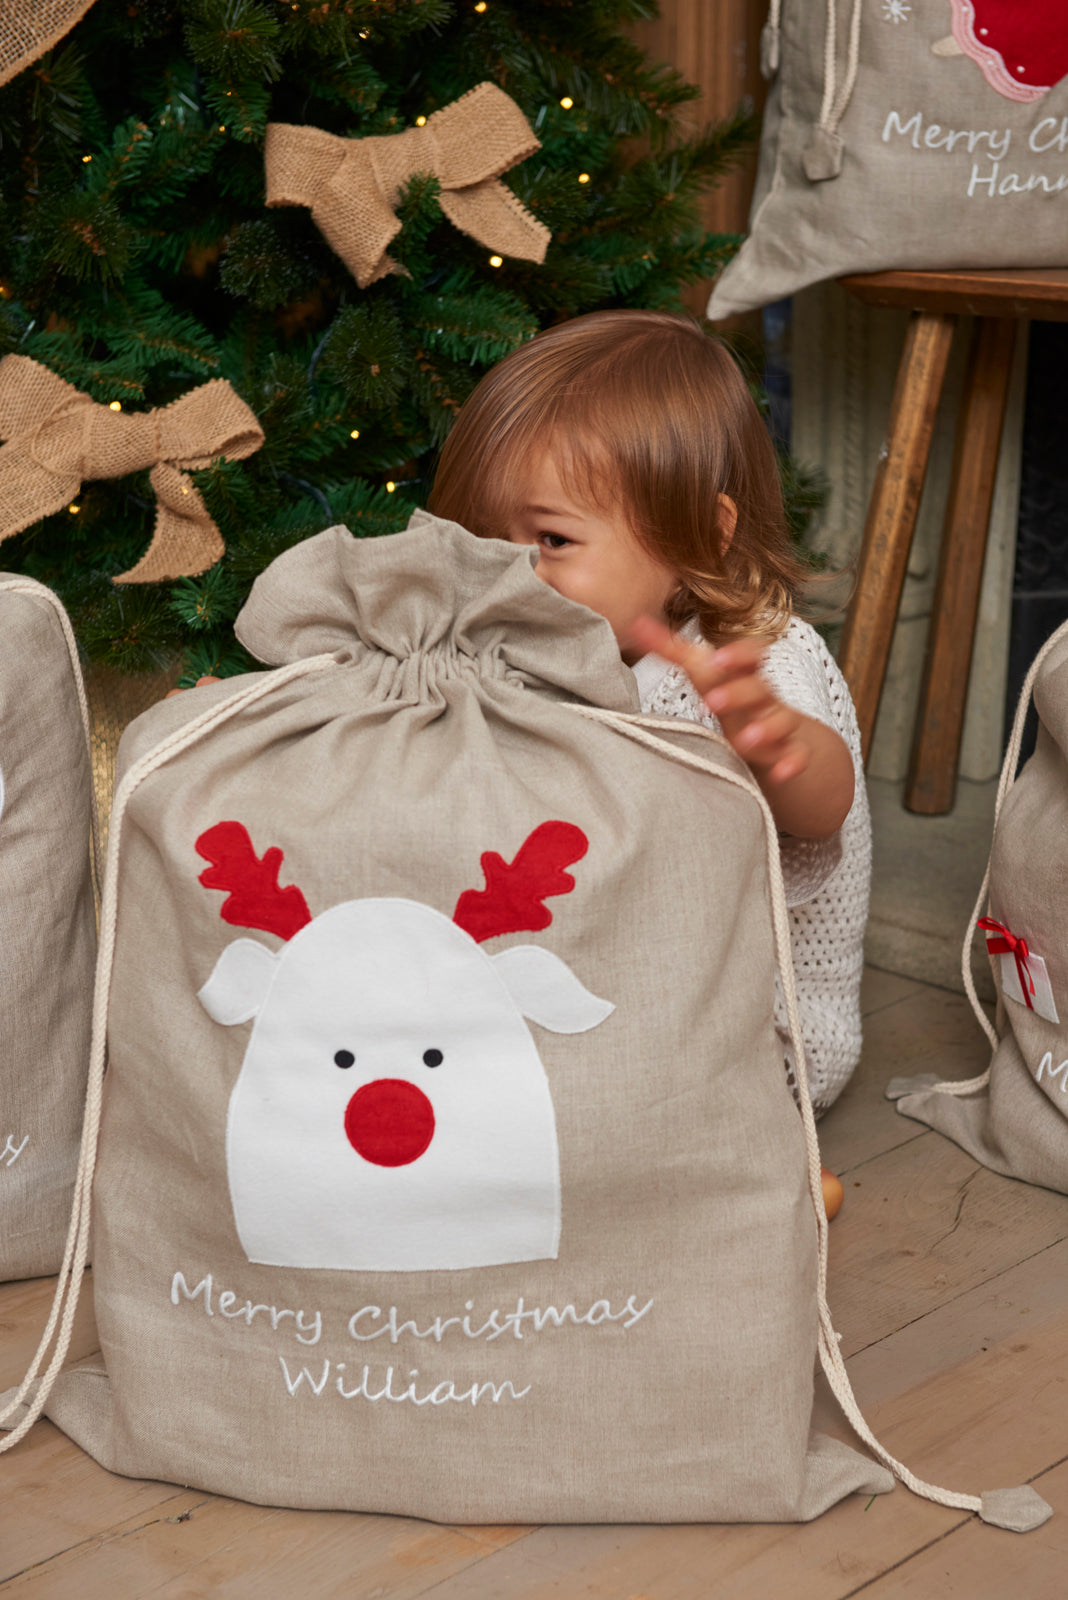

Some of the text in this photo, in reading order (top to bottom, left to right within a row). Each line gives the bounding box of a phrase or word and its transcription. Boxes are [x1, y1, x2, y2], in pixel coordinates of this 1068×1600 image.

[882, 111, 1011, 161] Merry
[170, 1271, 654, 1344] Merry Christmas
[279, 1356, 531, 1406] William
